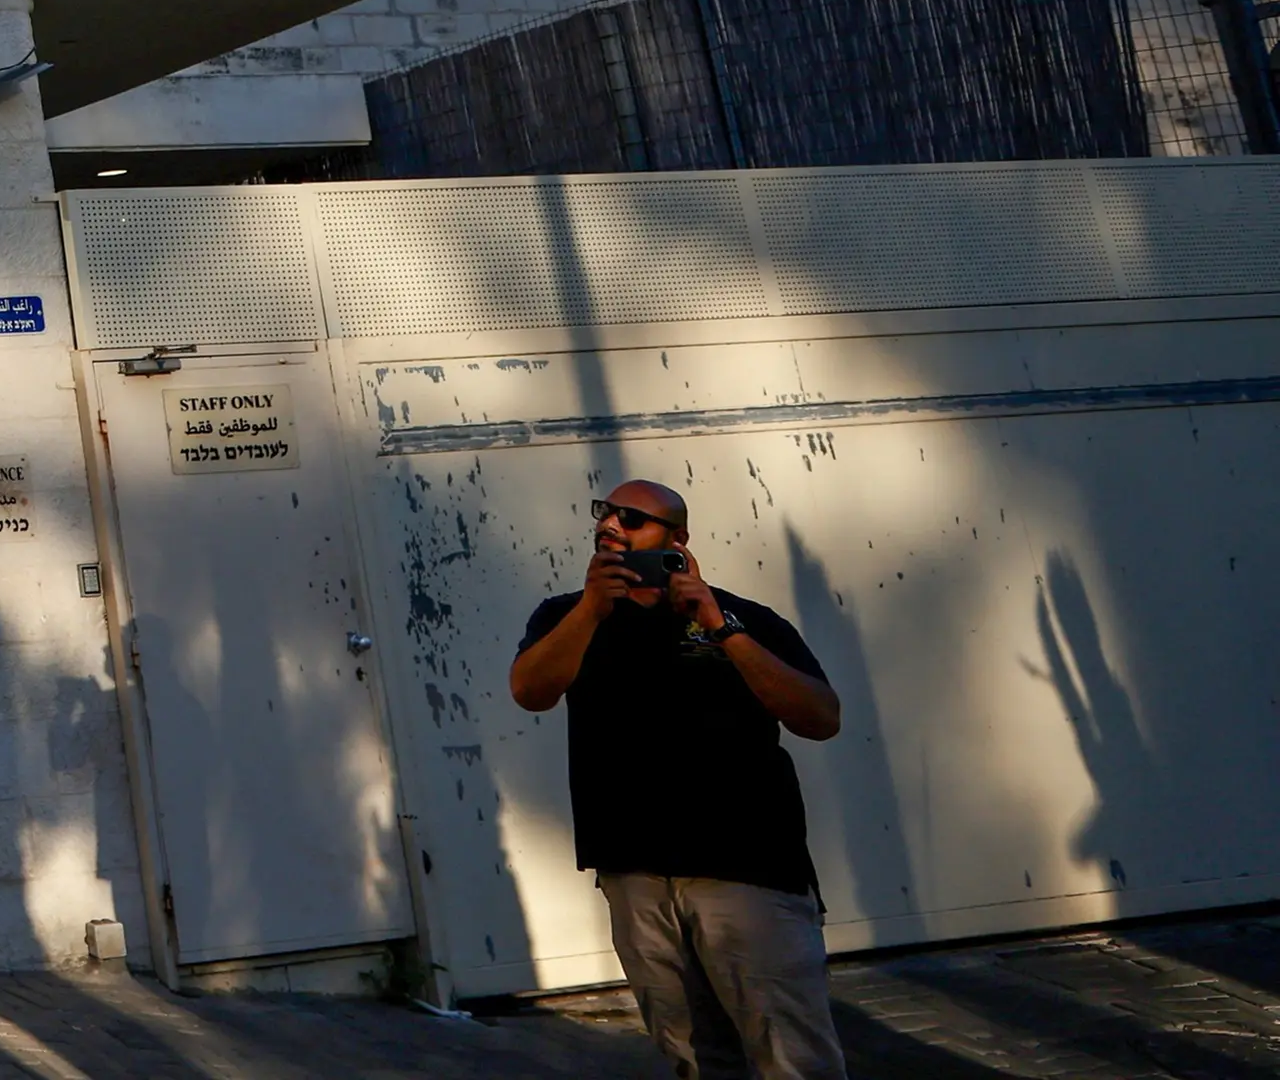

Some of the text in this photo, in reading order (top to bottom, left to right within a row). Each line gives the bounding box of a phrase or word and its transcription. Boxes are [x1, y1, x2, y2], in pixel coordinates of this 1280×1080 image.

[13, 299, 33, 314] راغب
[180, 394, 274, 412] STAFF ONLY
[185, 417, 277, 438] للموظفين فقط
[180, 440, 288, 461] לעובדים בלבד
